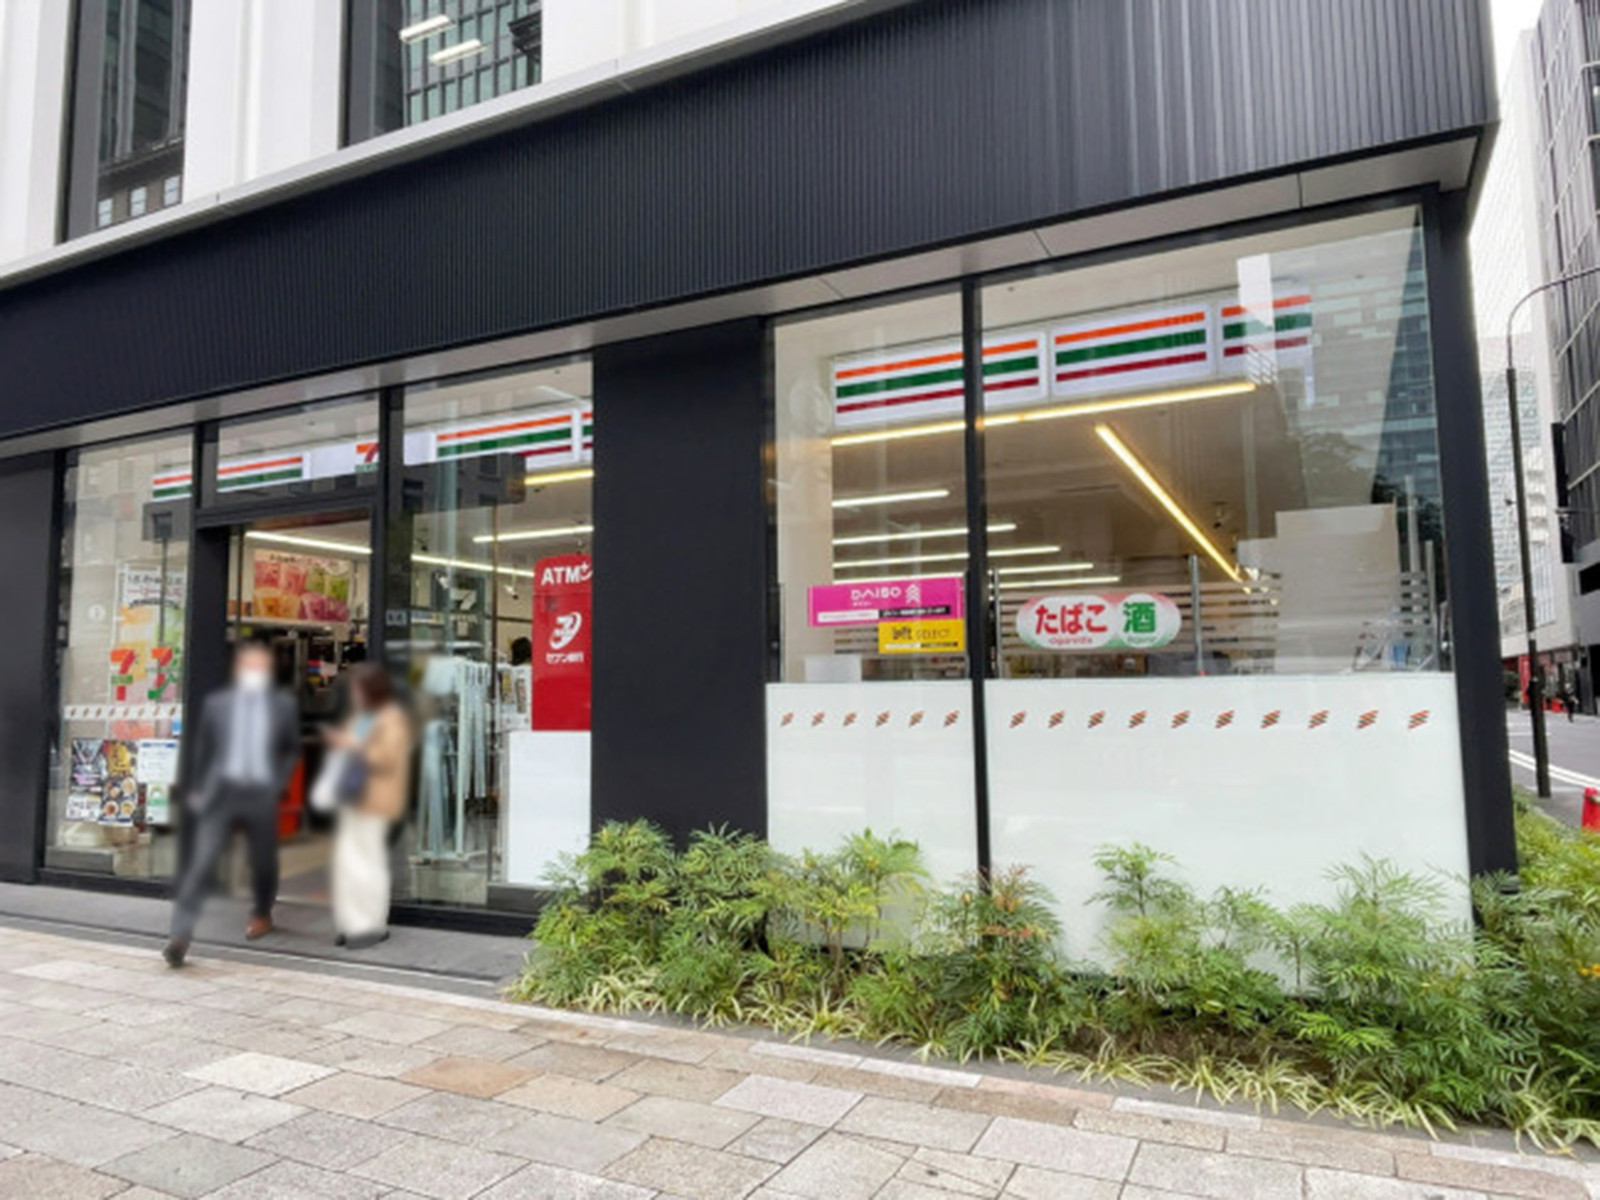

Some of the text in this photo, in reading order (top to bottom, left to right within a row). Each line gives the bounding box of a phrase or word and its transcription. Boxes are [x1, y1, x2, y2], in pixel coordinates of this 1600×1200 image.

[541, 565, 580, 586] ATM
[850, 587, 902, 600] DAISO
[1035, 602, 1157, 635] たばこ 酒
